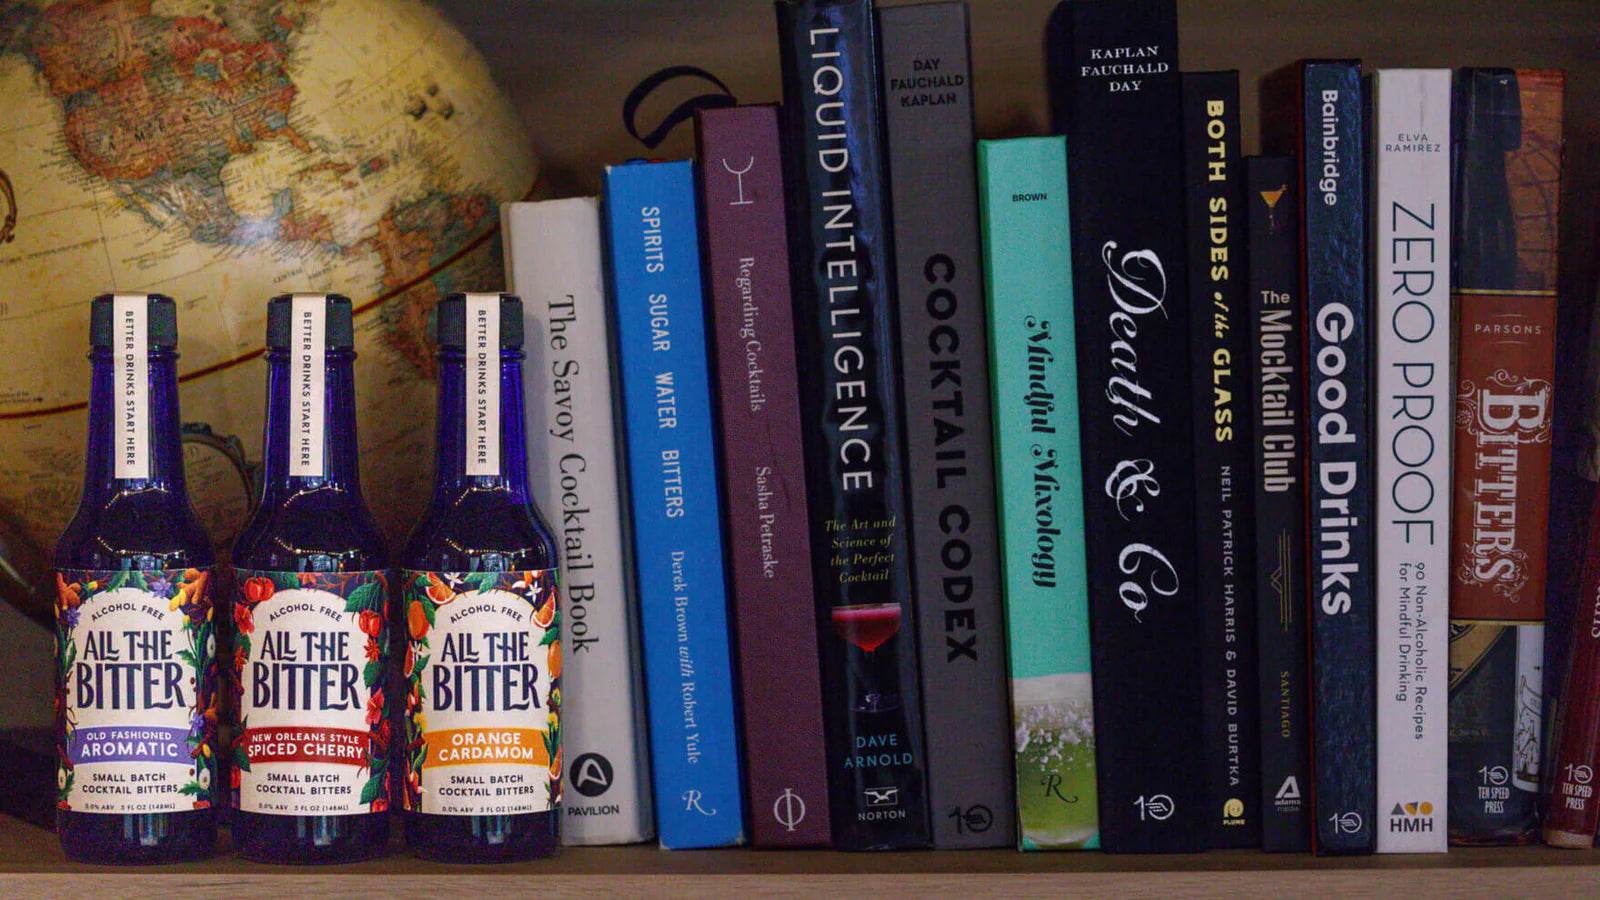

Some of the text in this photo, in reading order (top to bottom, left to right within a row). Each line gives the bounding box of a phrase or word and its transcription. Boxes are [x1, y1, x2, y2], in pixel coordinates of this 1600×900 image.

[1090, 45, 1159, 60] KAPLAN
[912, 58, 941, 72] DAY
[1081, 62, 1169, 77] FAUCHALD
[890, 75, 964, 91] FAUCHALD
[1109, 80, 1143, 92] DAY
[901, 93, 957, 107] KAPLAN
[1398, 133, 1429, 142] ELVA
[1319, 89, 1340, 206] Bainbridge
[1385, 144, 1441, 153] RAMIREZ
[1012, 193, 1048, 202] BROWN
[809, 27, 873, 491] LIQUID INTELLIGENCE
[1206, 99, 1233, 443] BOTH SIDES of the GLASS
[1260, 290, 1290, 304] The
[735, 257, 766, 412] Regarding Cocktails
[1474, 323, 1542, 335] PARSONS
[1101, 240, 1169, 438] Death
[641, 206, 685, 518] SPIRITS SUGAR WATER BITTERS
[1392, 201, 1435, 545] ZERO PROOF
[125, 310, 135, 465] BETTER DRINKS START HERE
[301, 312, 312, 466] BETTER DRINKS START HERE
[478, 310, 487, 464] BETTER DRINKS START HERE
[1259, 309, 1296, 492] Mocktail Club
[924, 253, 978, 663] COCKTAIL CODEX
[1023, 315, 1062, 588] Mindful Mixology
[1315, 302, 1359, 616] Good Drinks
[548, 294, 599, 654] The Savoy Cocktail Book
[1220, 465, 1232, 502] NEIL
[1105, 458, 1161, 522] &
[1473, 388, 1547, 582] BITTERS
[756, 466, 779, 578] Sasha Petraske
[824, 515, 897, 532] The Art and
[831, 533, 895, 550] Science of
[1222, 509, 1234, 576] PATRICK
[830, 552, 895, 567] the Perfect
[839, 570, 889, 584] Cocktail
[91, 603, 165, 622] ALCOHOL FREE
[269, 603, 343, 622] ALCOHOL FREE
[450, 604, 523, 624] ALCOHOL FREE
[1224, 584, 1236, 642] HARRIS
[1395, 562, 1412, 702] for Mindful Drinking
[83, 630, 172, 661] ALL THE
[260, 630, 349, 662] ALL THE
[440, 631, 530, 663] ALL THE
[1412, 562, 1428, 740] 90 Non-Alcoholic Recipes
[671, 551, 702, 765] Derek Brown with Robert Yule
[76, 662, 186, 710] BITTER
[252, 661, 362, 711] BITTER
[432, 663, 541, 712] BITTER
[1226, 669, 1237, 716] DAVID
[1280, 670, 1291, 738] SANTIAGO
[86, 731, 172, 741] OLD FASHIONED
[252, 733, 359, 744] NEW ORLEANS STYLE
[451, 732, 522, 746] ORANGE
[856, 733, 898, 748] DAVE
[81, 742, 179, 758] AROMATIC
[247, 743, 364, 758] SPICED CHERRY
[438, 746, 534, 761] CARDAMOM
[1227, 723, 1240, 786] BURTKA
[844, 752, 914, 769] ARNOLD
[92, 773, 166, 782] SMALL BATCH
[267, 773, 340, 783] SMALL BATCH
[450, 774, 524, 785] SMALL BATCH
[82, 784, 178, 794] COCKTAIL BITTERS
[256, 784, 352, 795] COCKTAIL BITTERS
[438, 786, 534, 797] COCKTAIL BITTERS
[1477, 786, 1510, 800] TEN SPEED
[1562, 783, 1593, 797] TEN SPEED
[567, 805, 620, 816] PAVILION
[681, 789, 717, 816] R
[1484, 800, 1504, 814] PRESS
[1565, 798, 1585, 811] PRESS
[857, 810, 906, 822] NORTON
[1390, 818, 1433, 833] HMH
